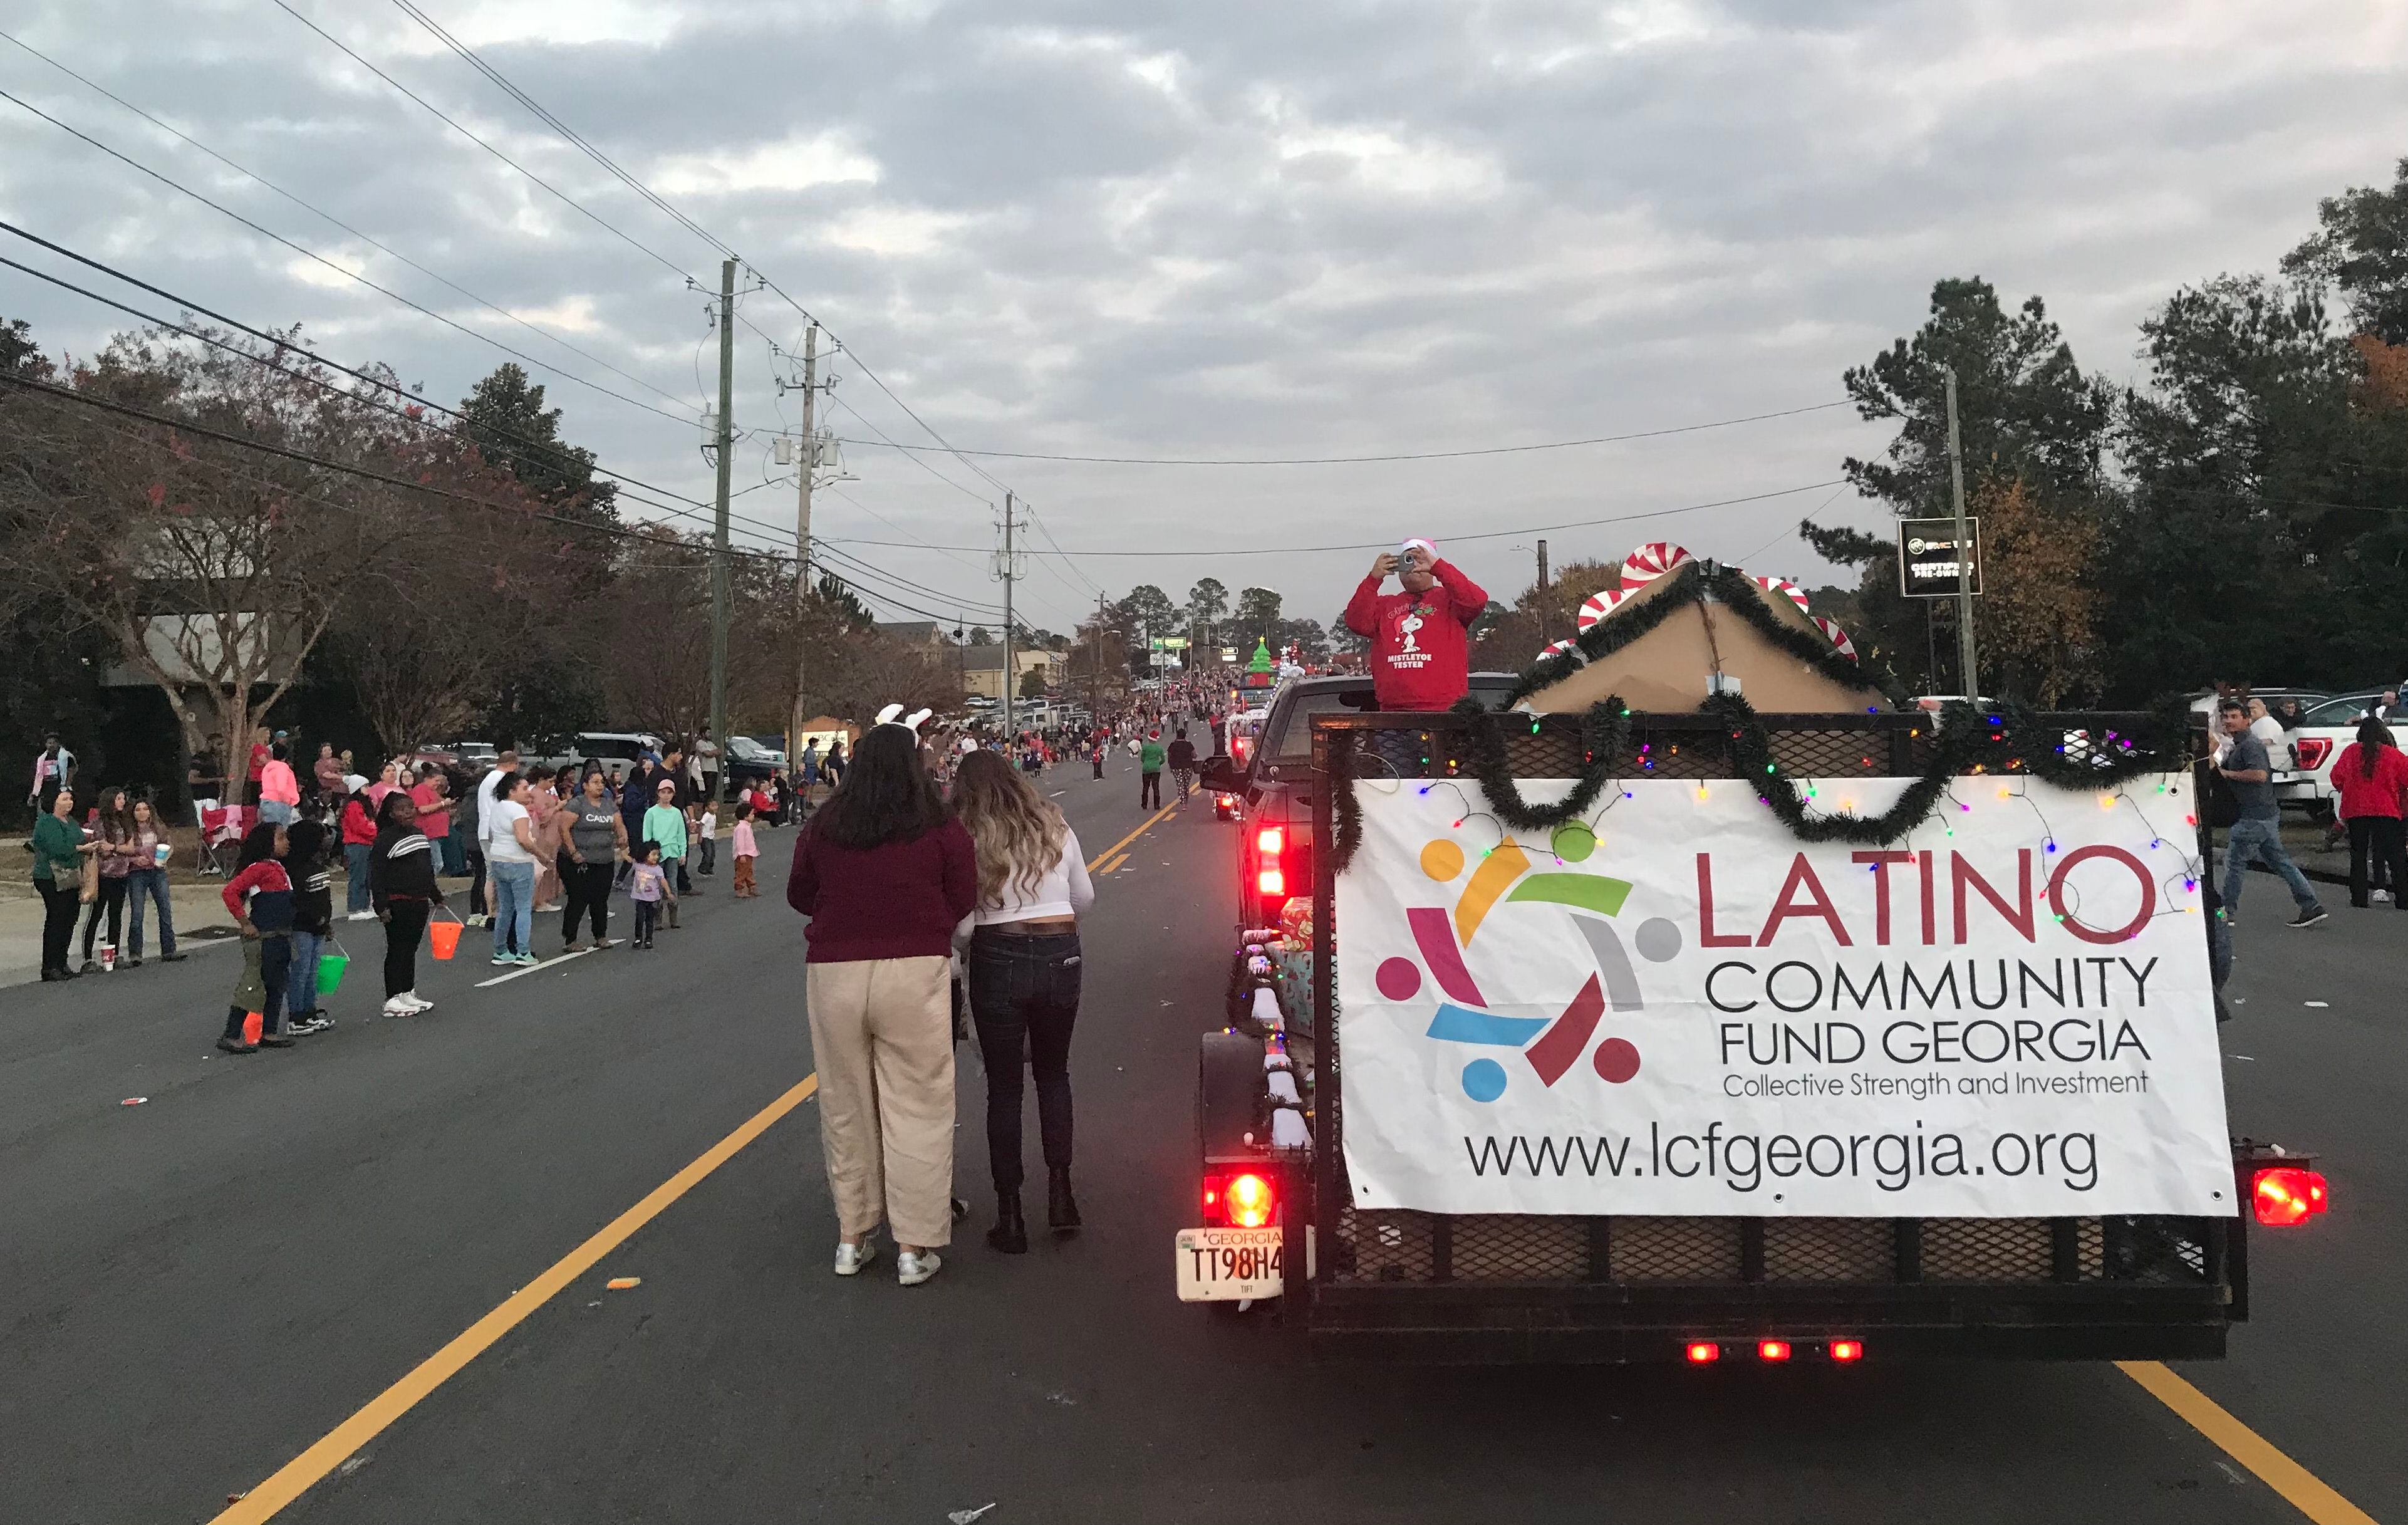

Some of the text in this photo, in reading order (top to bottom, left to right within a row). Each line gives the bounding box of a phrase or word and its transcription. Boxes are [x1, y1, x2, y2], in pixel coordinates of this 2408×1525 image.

[1911, 562, 1975, 571] CERTIFID
[1914, 570, 1971, 578] PRE-OWND
[1388, 653, 1432, 662] MISTLETOE
[1696, 845, 2156, 947] LATINO
[1705, 957, 2159, 1013] COMMUNITY
[1721, 1019, 2151, 1065] FUND GEORGIA
[1723, 1070, 2149, 1101] Collective Strength and Investment
[1464, 1120, 2097, 1192] www.lcfgeorgia.org
[1208, 1232, 1282, 1245] GEORGIA
[1190, 1246, 1283, 1282] TT98H4
[1241, 1285, 1253, 1293] TIFT
